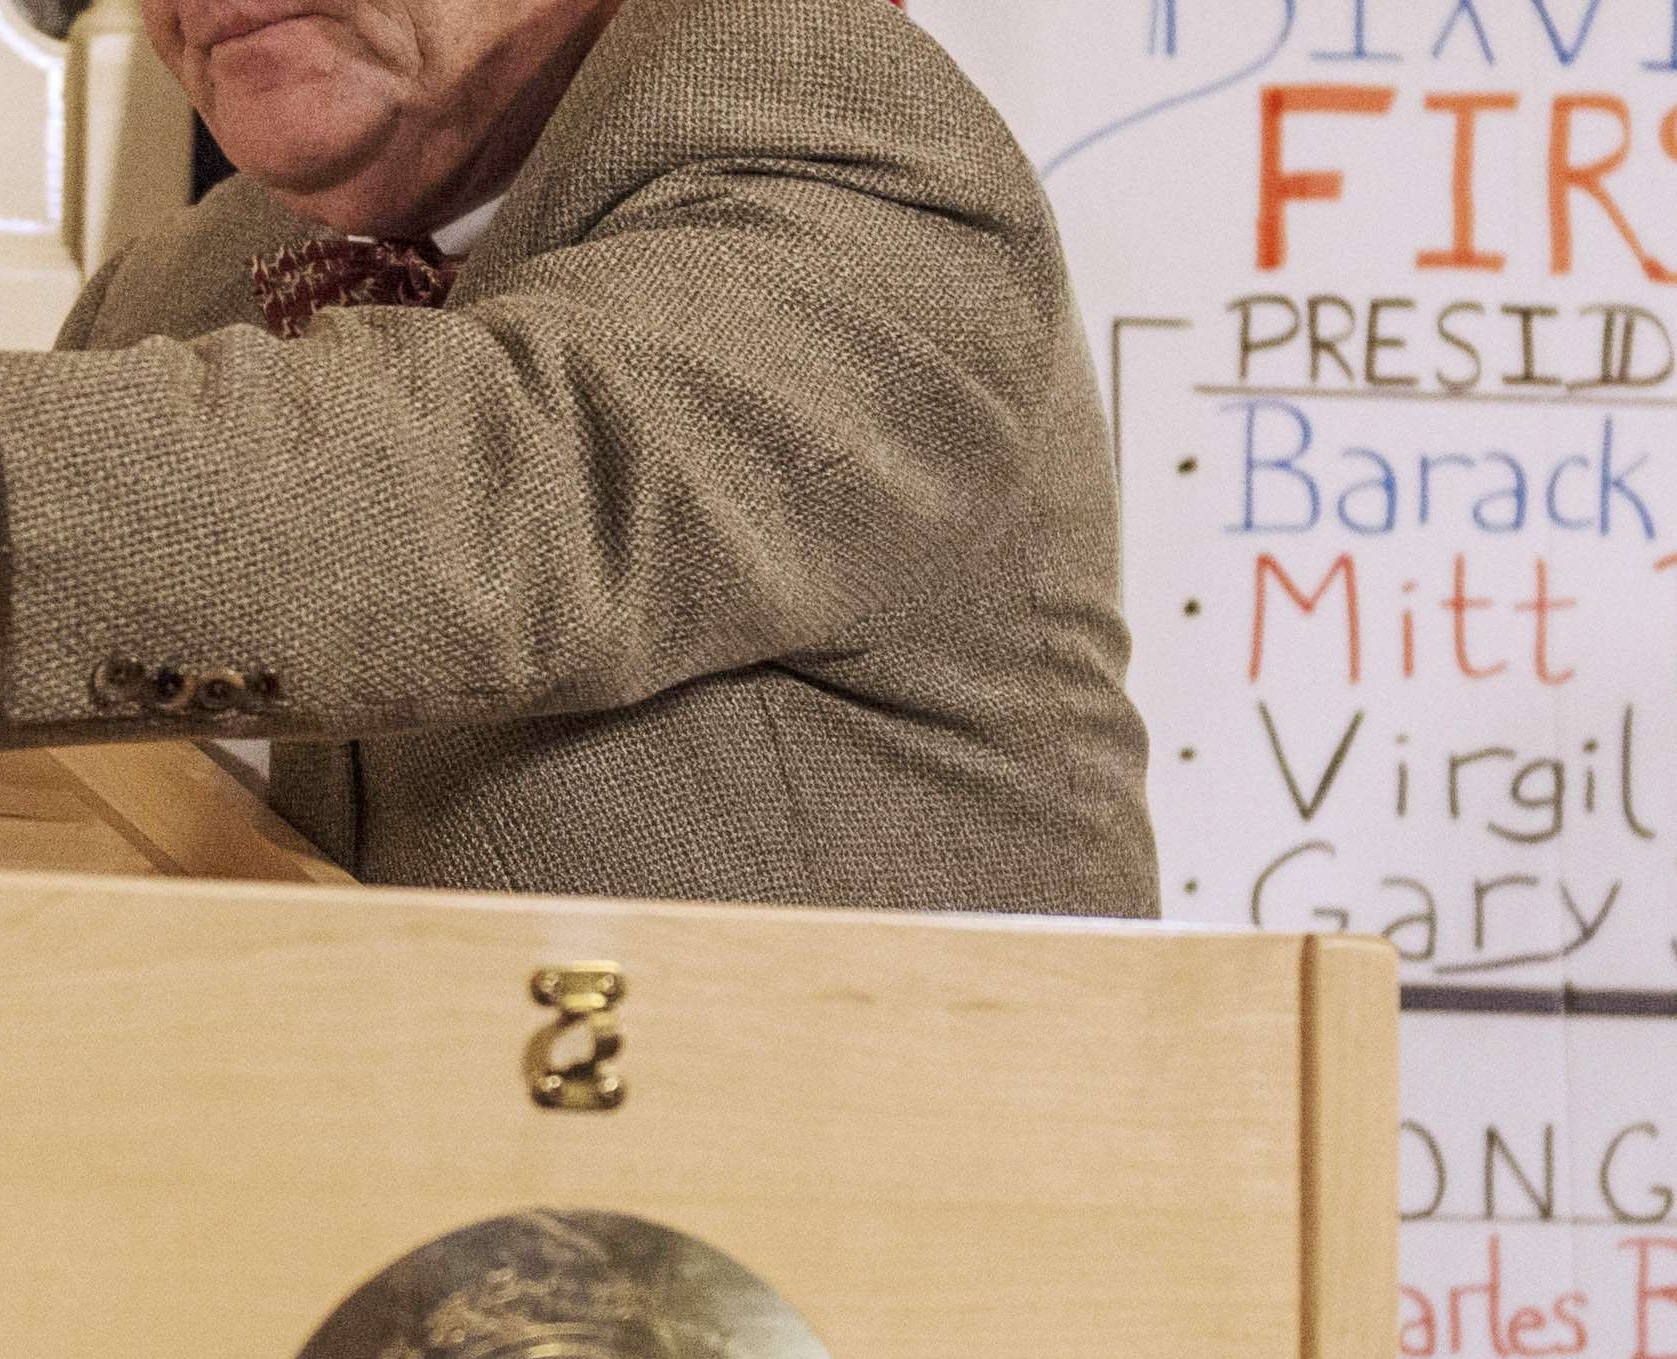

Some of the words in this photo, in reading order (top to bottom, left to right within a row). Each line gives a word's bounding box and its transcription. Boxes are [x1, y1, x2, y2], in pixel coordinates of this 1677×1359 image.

[1219, 397, 1657, 541] Barack
[1247, 551, 1578, 686] Mitt
[1256, 701, 1657, 843] Virgil
[1250, 840, 1622, 974] Gary
